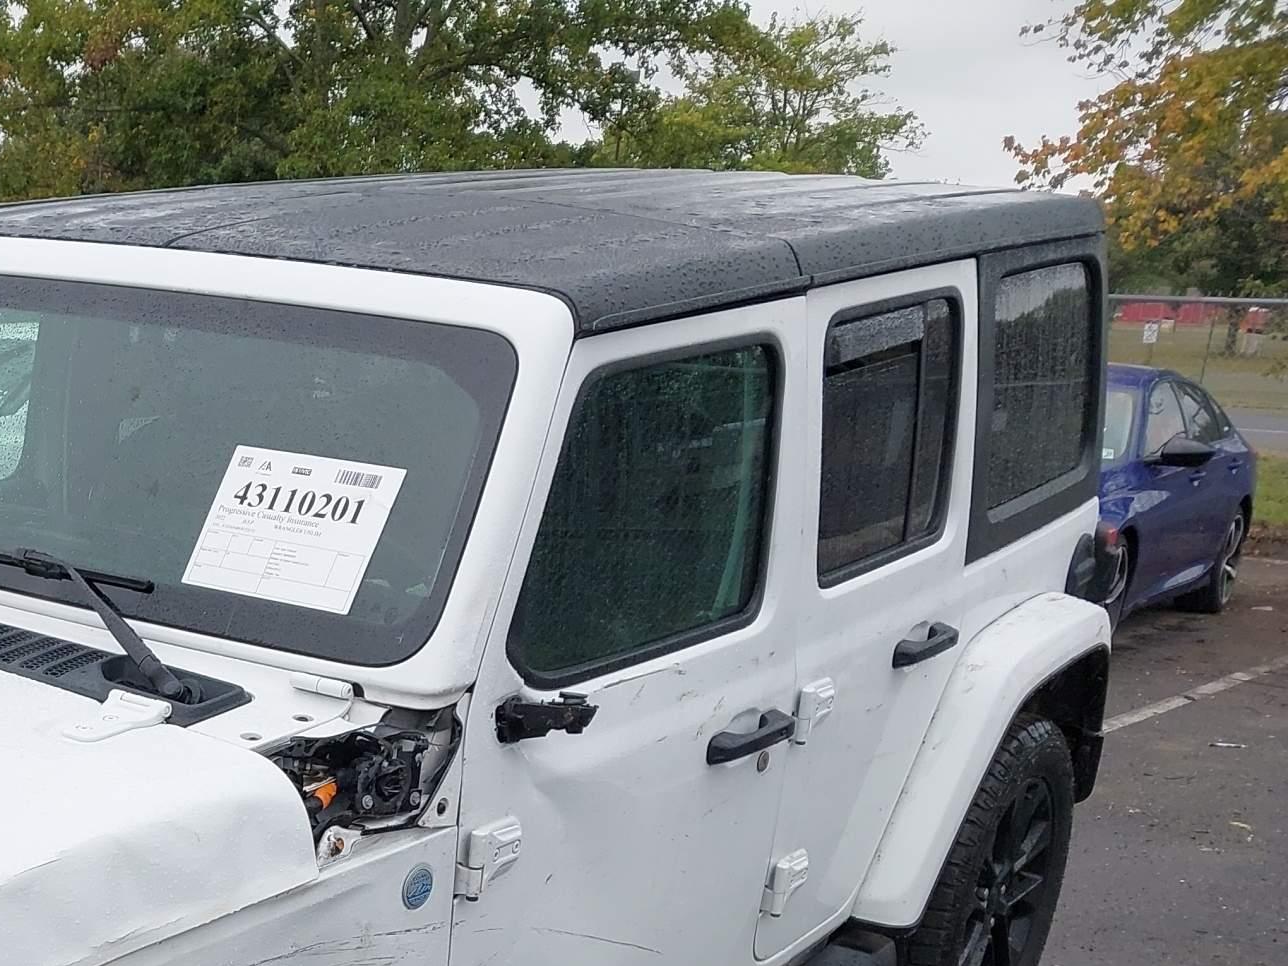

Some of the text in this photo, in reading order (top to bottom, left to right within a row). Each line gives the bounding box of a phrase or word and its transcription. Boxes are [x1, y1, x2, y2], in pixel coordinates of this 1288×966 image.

[218, 504, 256, 518] Progressive
[257, 511, 286, 524] Casualty
[287, 517, 320, 529] Insurance
[233, 481, 366, 525] 43110201
